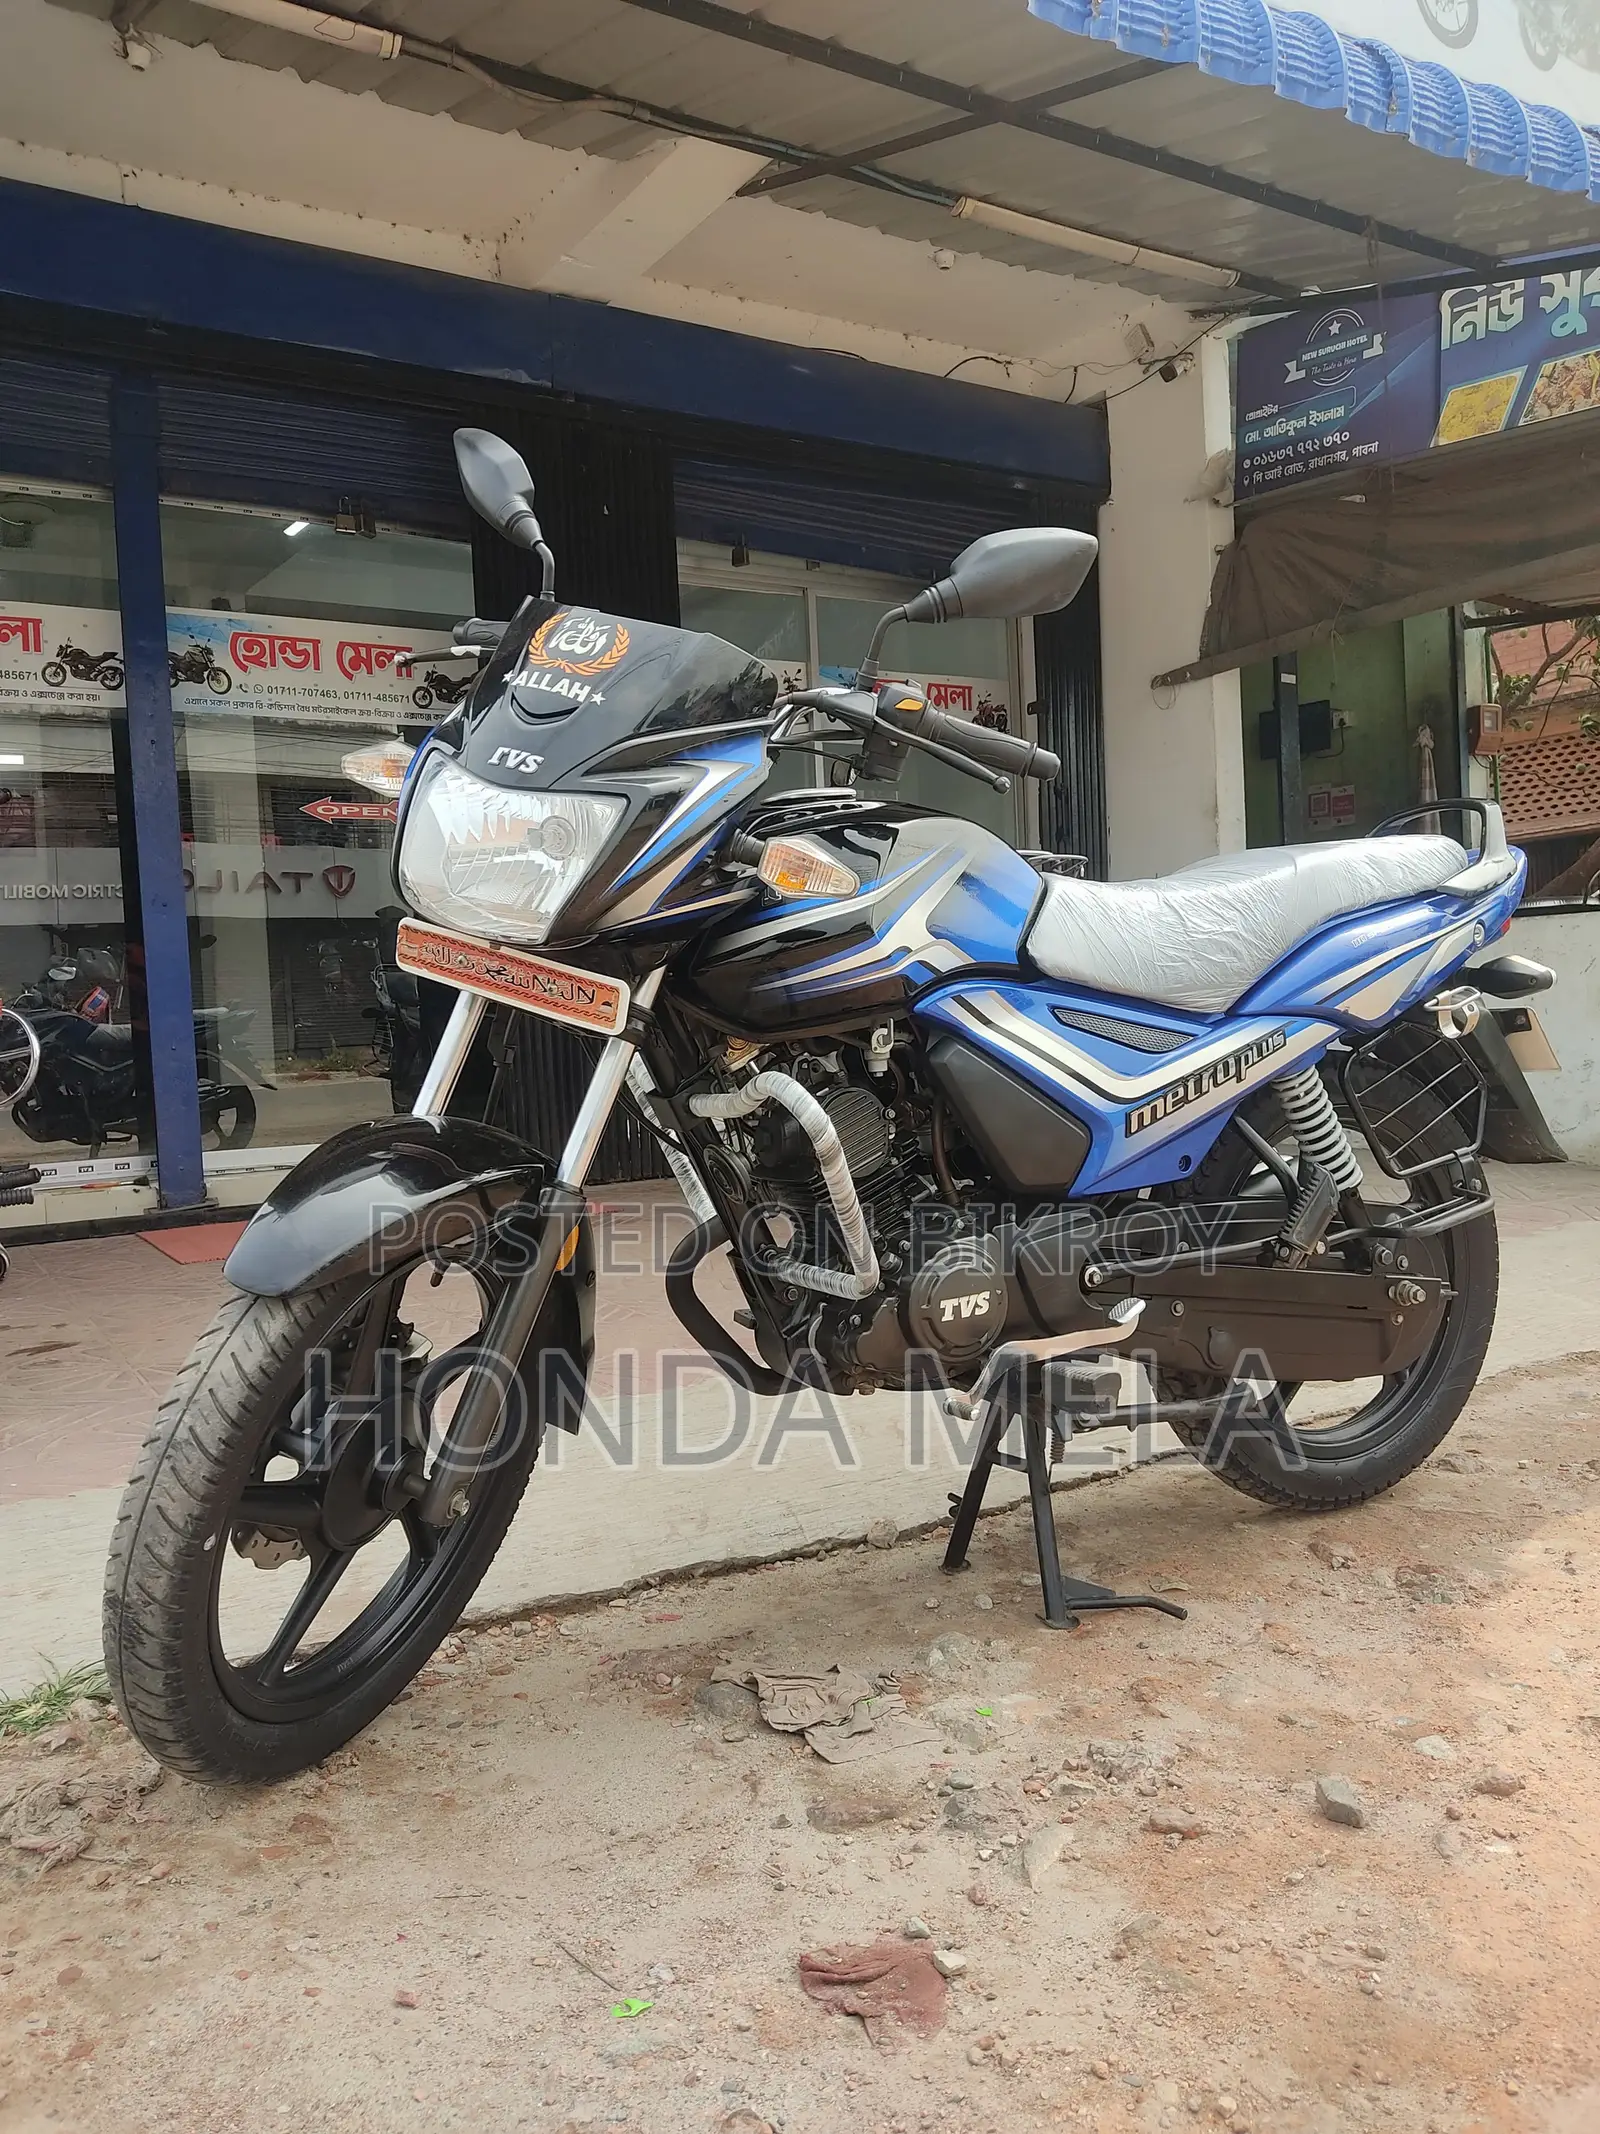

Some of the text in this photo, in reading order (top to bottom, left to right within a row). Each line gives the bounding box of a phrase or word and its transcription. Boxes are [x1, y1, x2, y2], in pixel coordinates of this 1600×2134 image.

[1301, 334, 1368, 362] NEW SURUCHI HOTEL
[1311, 366, 1321, 375] The
[1263, 417, 1307, 436] আতিকুল
[1308, 405, 1345, 427] ইসলাম
[1297, 438, 1320, 455] ৭৭২
[1323, 431, 1350, 447] ৩৭০
[1253, 470, 1264, 485] পি
[1264, 467, 1283, 481] আই
[1351, 441, 1379, 458] পাবনা
[229, 631, 413, 682] হোন্ডা মেলা
[67, 692, 84, 701] করা
[267, 685, 410, 704] 01711-707463, 01711-485671
[510, 670, 592, 704] ALLAH
[926, 683, 973, 711] মেলা
[184, 697, 208, 706] এখানে
[209, 699, 231, 708] সকল
[232, 701, 254, 710] প্রকার
[297, 703, 311, 713] বৈধ
[487, 746, 545, 774] TVS
[316, 805, 398, 818] OPEN
[940, 1290, 991, 1322] TVS
